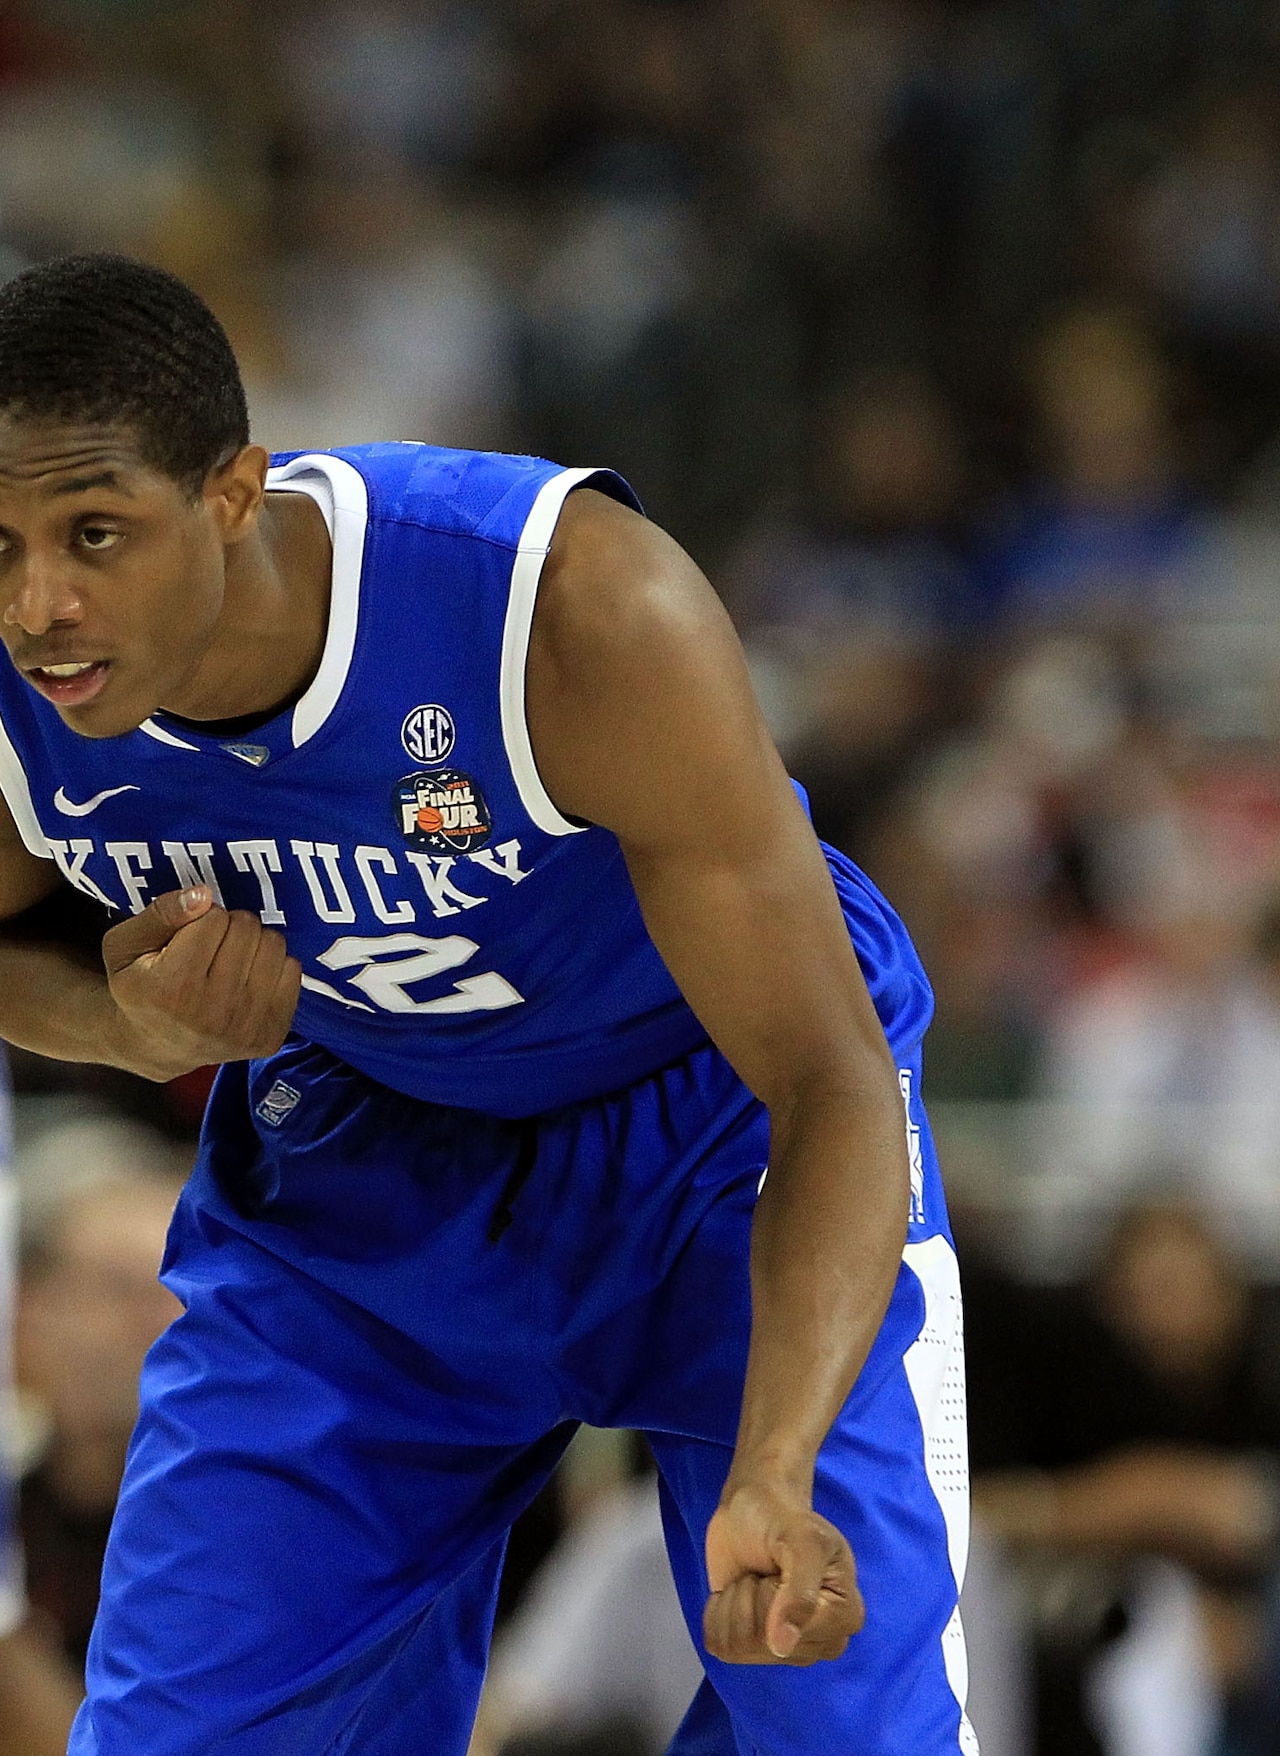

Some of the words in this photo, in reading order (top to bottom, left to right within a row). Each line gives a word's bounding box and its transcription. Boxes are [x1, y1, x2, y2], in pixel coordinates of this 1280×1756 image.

[407, 710, 449, 757] SEC
[417, 787, 475, 808] FINAL
[48, 838, 535, 926] KENTUCKY
[301, 932, 526, 1015] 2
